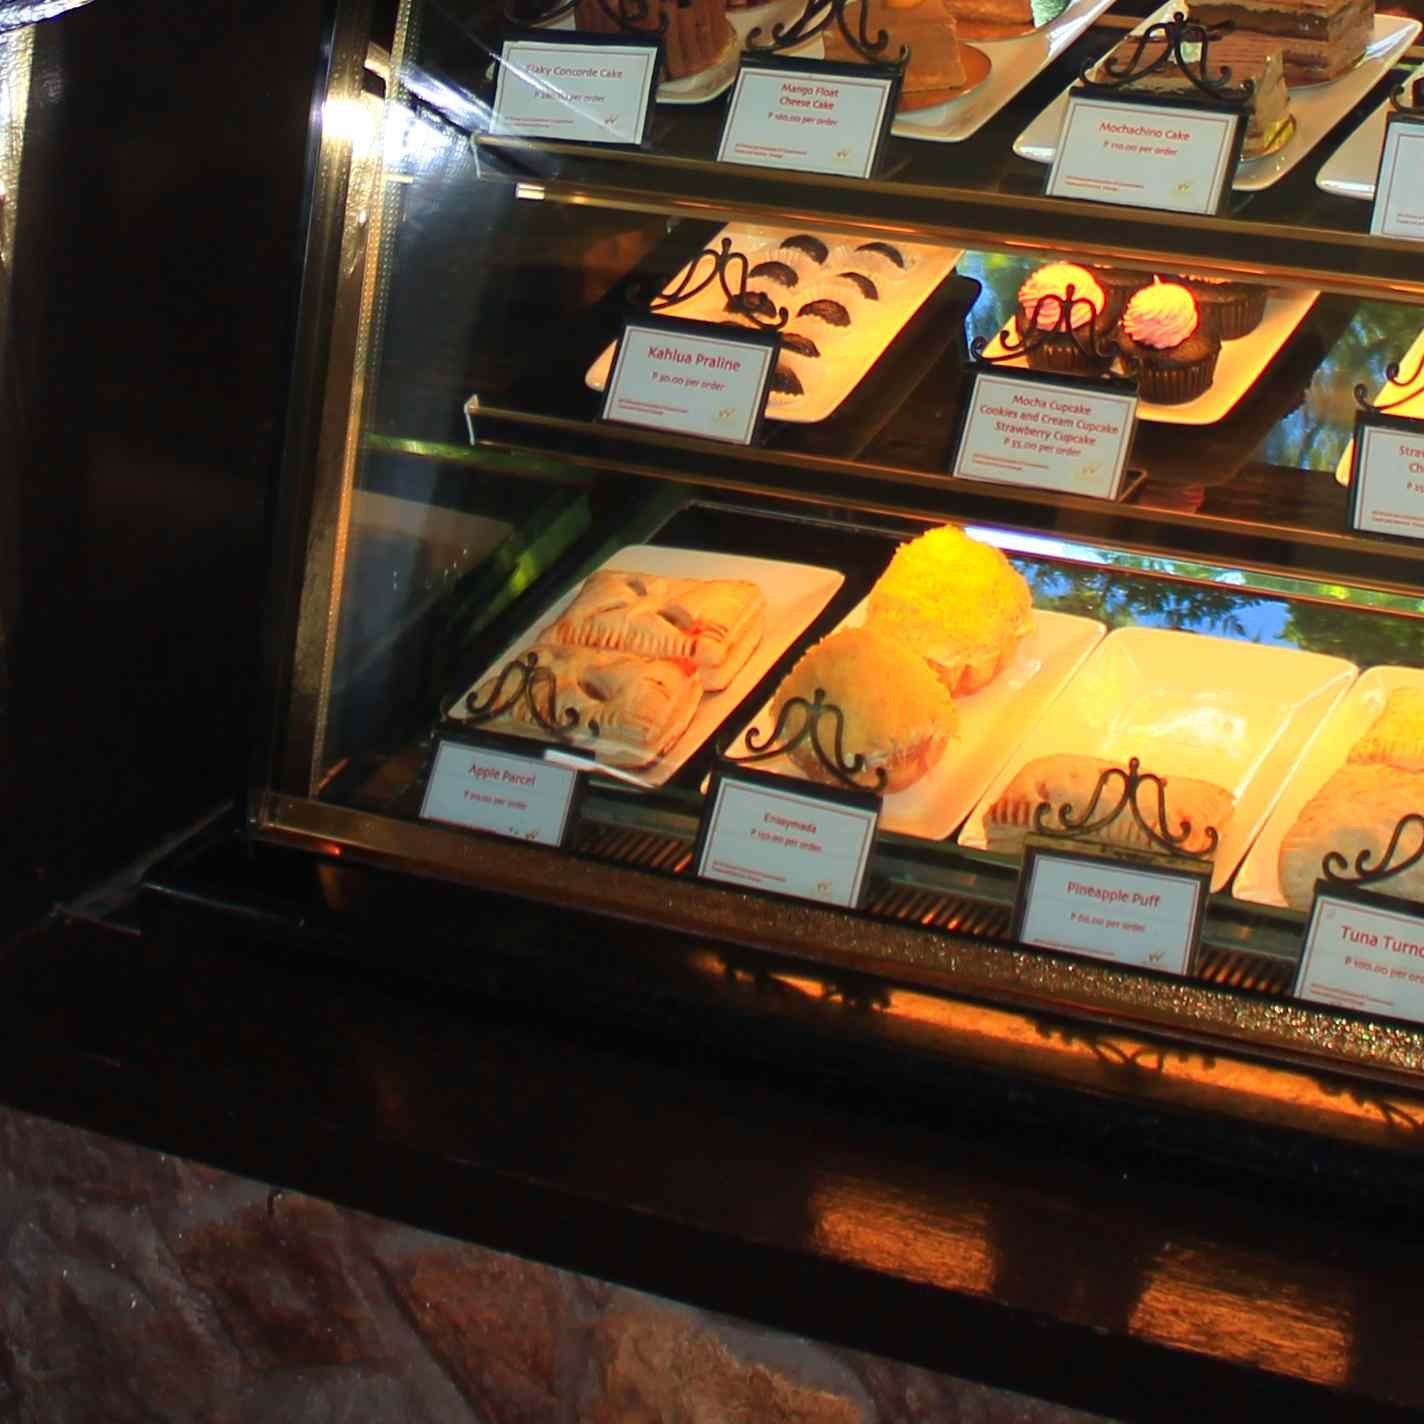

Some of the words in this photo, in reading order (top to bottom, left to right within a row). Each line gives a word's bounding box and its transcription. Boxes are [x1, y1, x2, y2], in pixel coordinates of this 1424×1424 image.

[600, 68, 623, 78] Cake
[782, 83, 813, 97] Mango
[815, 87, 839, 97] Float
[779, 97, 810, 108] Cheese
[812, 100, 834, 110] Cake
[1100, 122, 1162, 138] Mochachino
[1165, 130, 1191, 141] Cake
[648, 347, 692, 364] Kahlua
[696, 353, 741, 371] Praline
[1013, 395, 1047, 407] Mocha
[1049, 401, 1091, 415] Cupcake
[980, 405, 1018, 417] Cookies
[1021, 412, 1038, 421] and
[1041, 414, 1073, 425] Cream
[1076, 420, 1119, 433] Cupcake
[996, 421, 1051, 439] Strawberry
[1054, 431, 1096, 445] Cupcake
[469, 764, 500, 781] Apple
[503, 770, 536, 785] Parcel
[1067, 880, 1129, 904] Pineapple
[1132, 892, 1160, 908] Puff
[1341, 926, 1377, 947] Tuna
